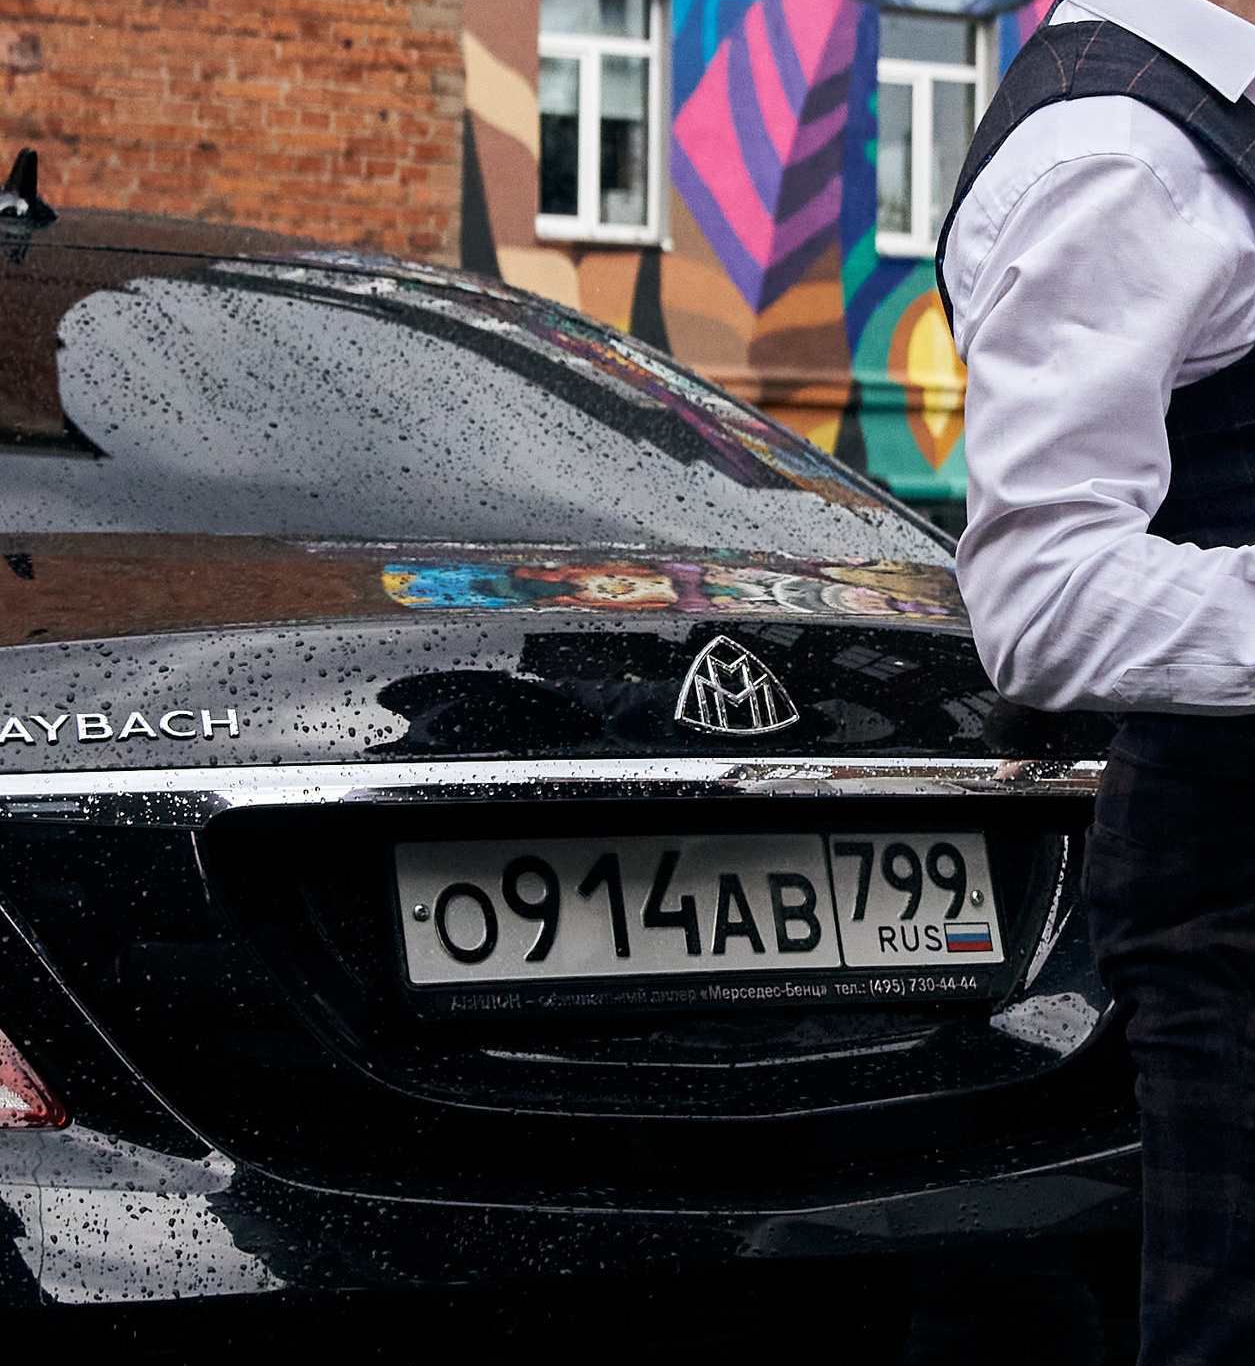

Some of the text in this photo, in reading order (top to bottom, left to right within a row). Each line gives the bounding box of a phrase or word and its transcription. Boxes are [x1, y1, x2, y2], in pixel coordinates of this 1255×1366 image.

[833, 841, 968, 921] 799
[880, 925, 943, 953] RUS
[700, 981, 828, 1003] «Мерседес-Бенц»
[834, 983, 866, 996] тел.:
[869, 978, 906, 997] (495)
[909, 975, 978, 993] 730-44-44
